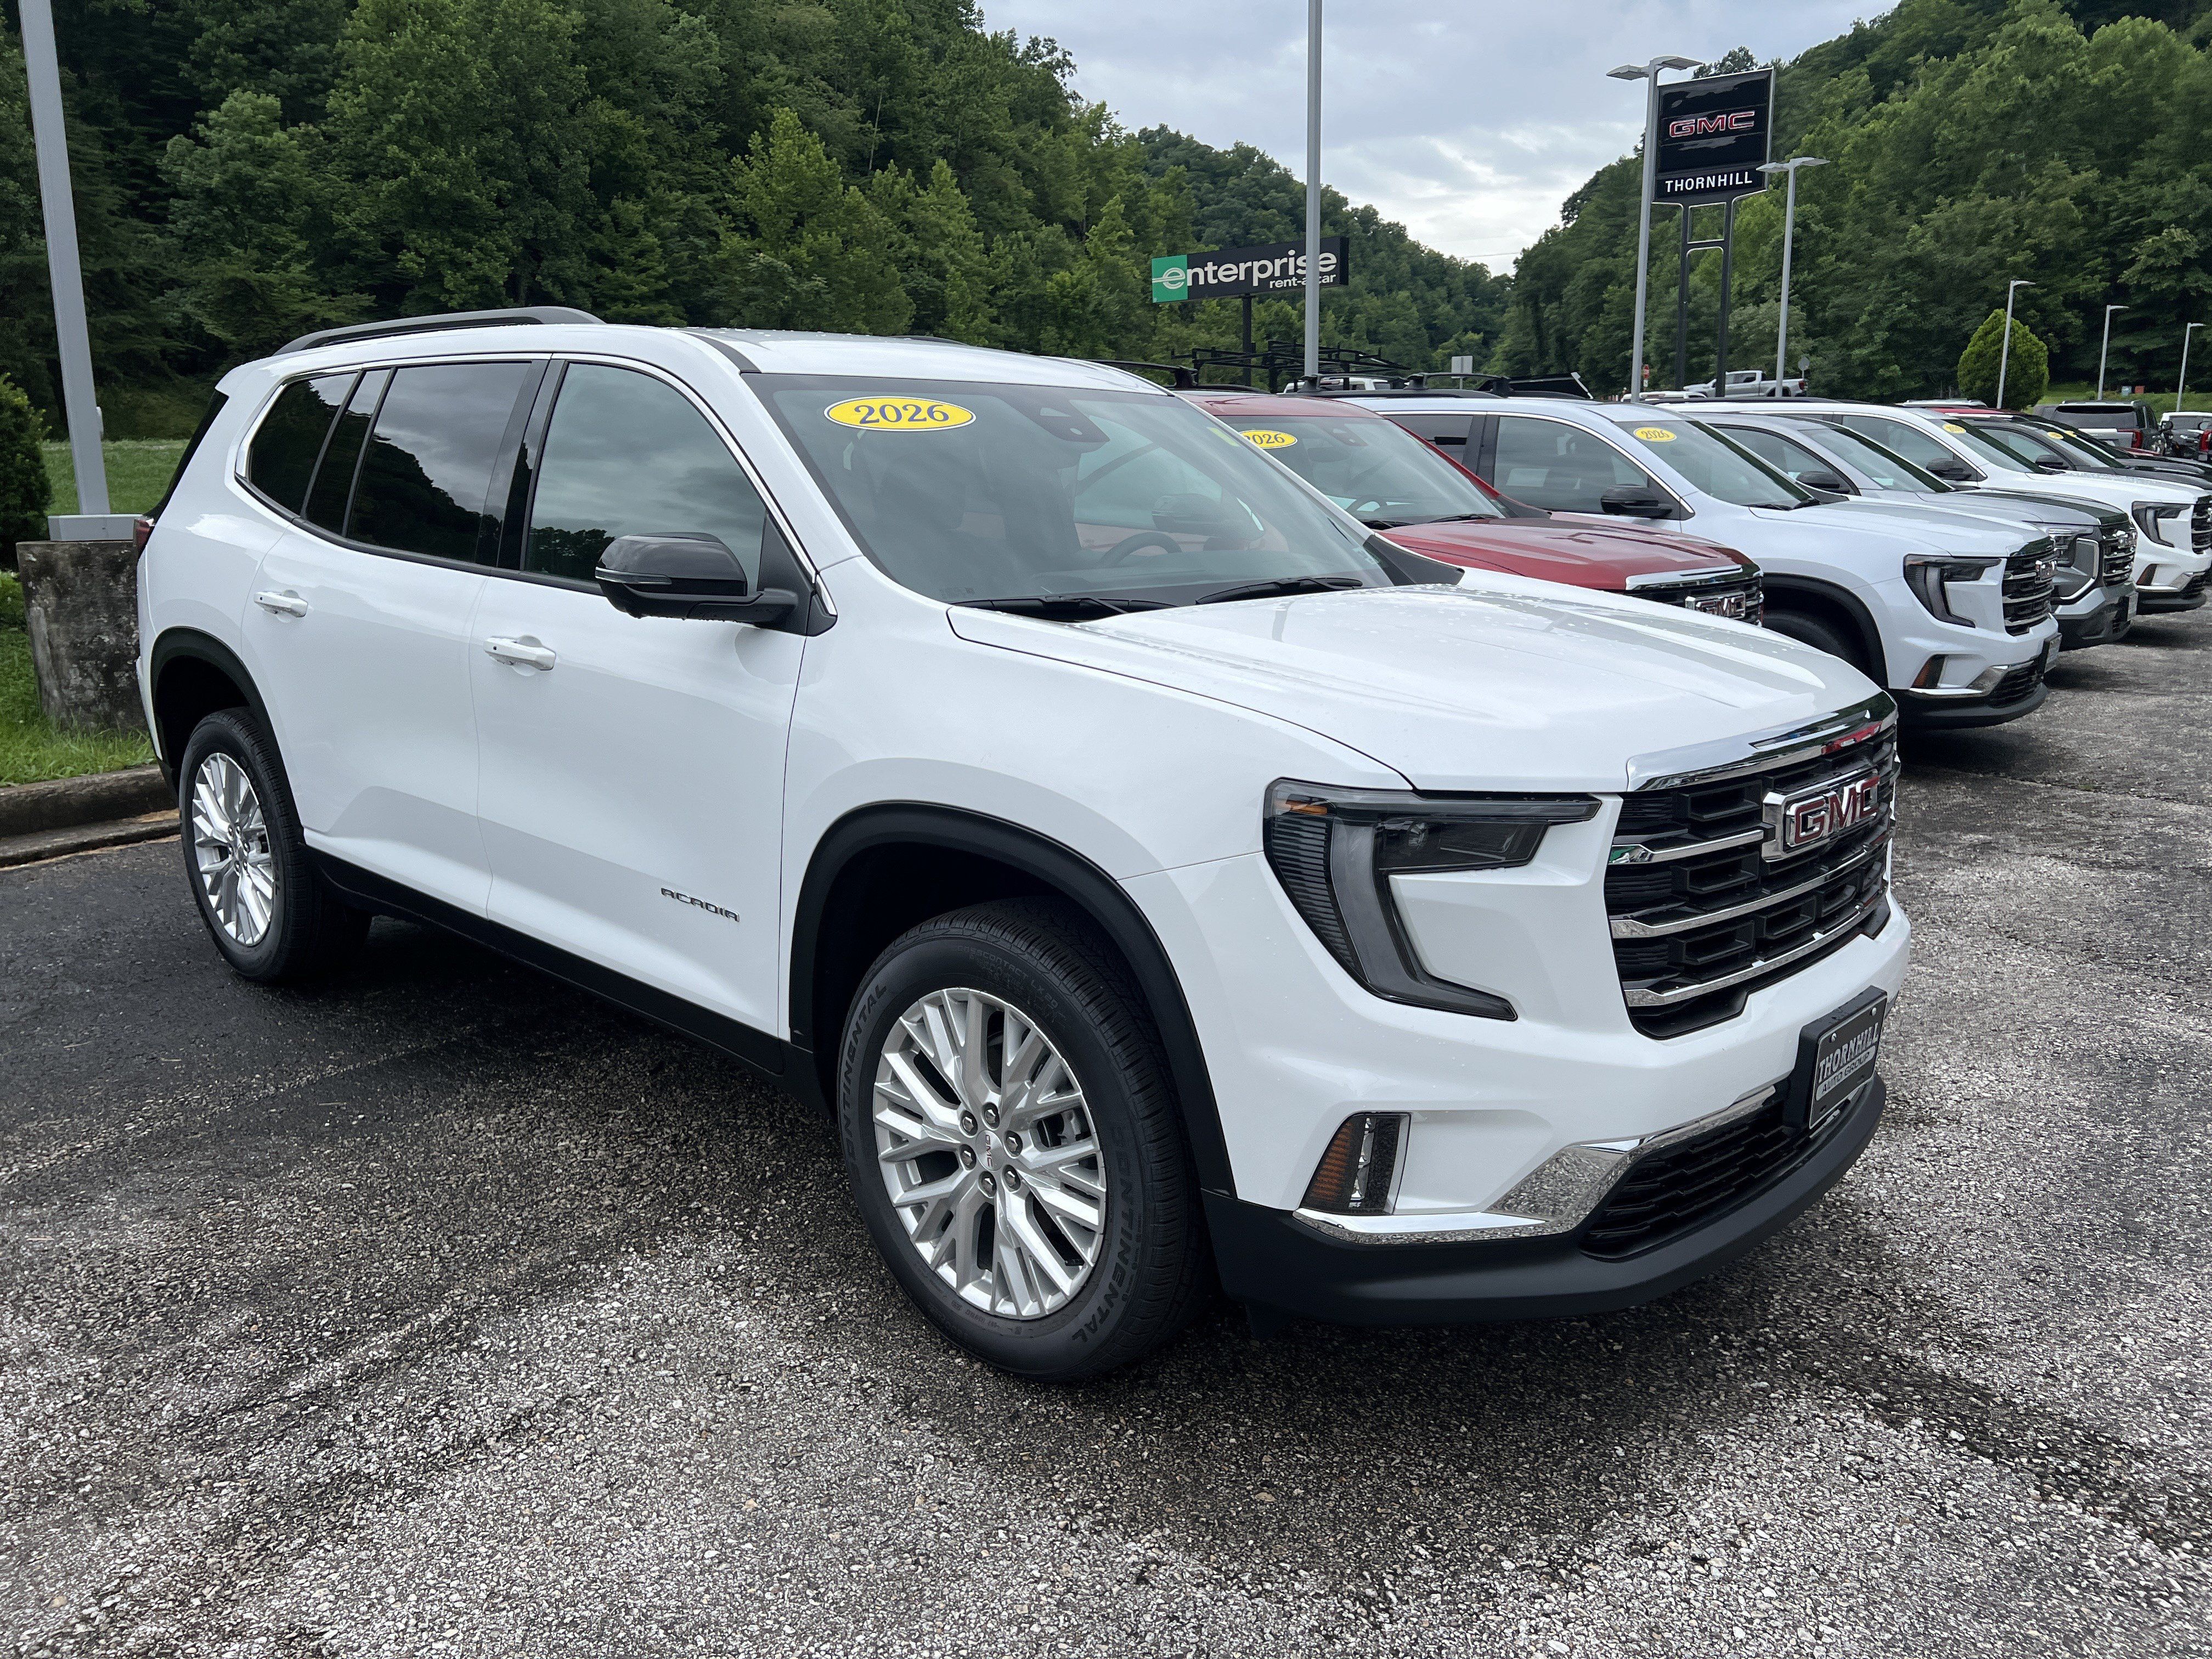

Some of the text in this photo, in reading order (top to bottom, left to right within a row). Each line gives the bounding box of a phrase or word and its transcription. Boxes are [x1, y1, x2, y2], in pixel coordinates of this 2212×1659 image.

[1669, 111, 1755, 137] GMC
[1665, 171, 1752, 193] THORNHILL
[1162, 250, 1337, 289] enterprise
[854, 404, 950, 425] 2026
[1787, 776, 1880, 847] GMC
[661, 887, 740, 923] ACADIA
[1818, 1022, 1879, 1084] THORNHILL
[1821, 1069, 1843, 1094] AUTO
